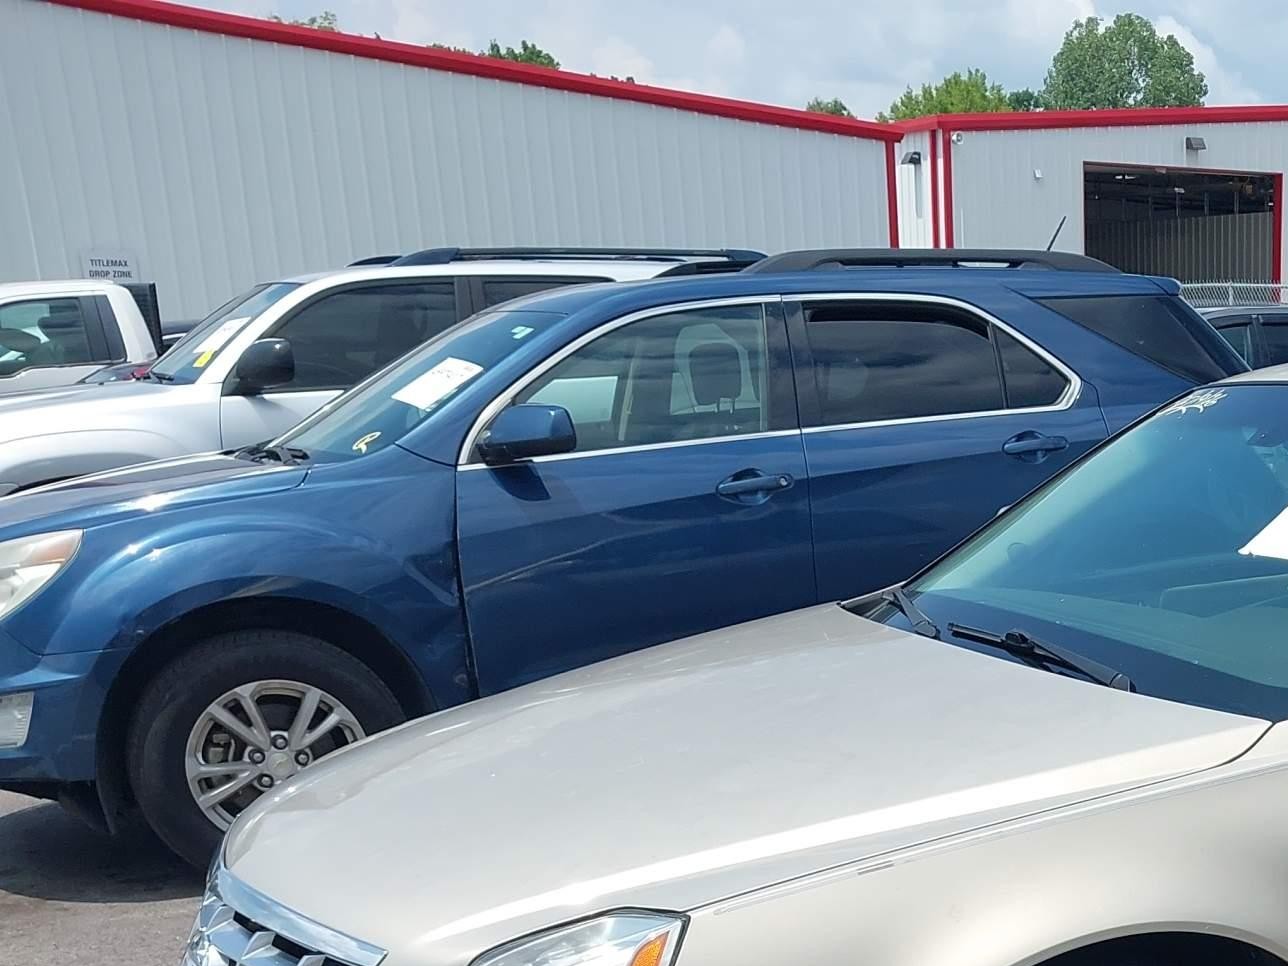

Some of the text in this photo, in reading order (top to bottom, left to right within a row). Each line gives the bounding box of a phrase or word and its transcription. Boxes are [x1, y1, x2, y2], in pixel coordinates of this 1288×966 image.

[90, 259, 128, 267] TITLEMAX
[89, 270, 133, 278] DROP ZONE
